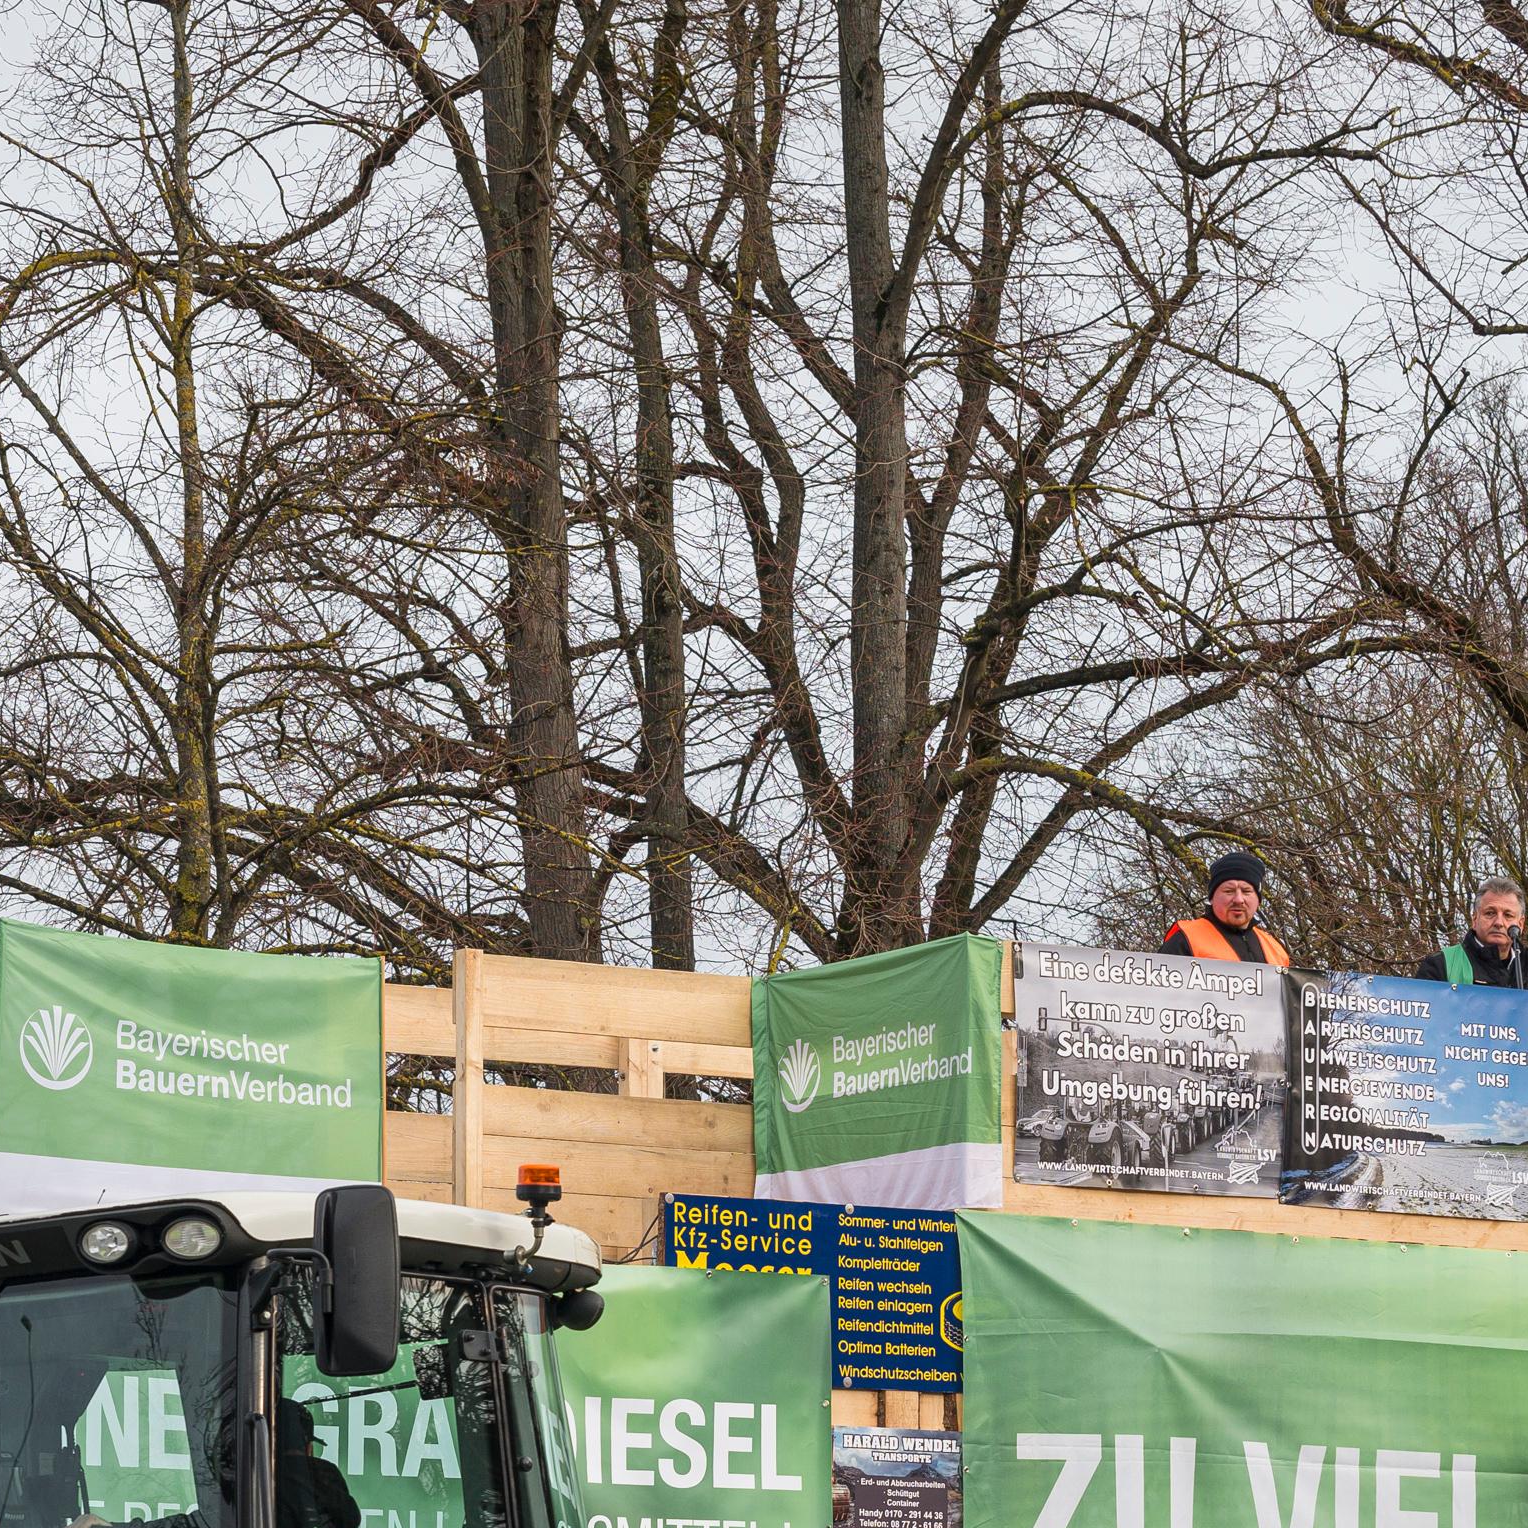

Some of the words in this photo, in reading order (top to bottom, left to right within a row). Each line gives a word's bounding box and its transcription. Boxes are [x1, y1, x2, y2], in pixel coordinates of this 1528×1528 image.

[1039, 951, 1089, 980] Eine
[1093, 955, 1183, 988] defekte
[1188, 962, 1263, 999] Ampel
[1060, 991, 1121, 1022] kann
[1125, 1004, 1155, 1025] zu
[1159, 1003, 1245, 1034] großen
[1304, 991, 1430, 1018] BIENENSCHUTZ
[1304, 1020, 1424, 1045] ARTENSCHUTZ
[1460, 1022, 1485, 1039] MIT
[1489, 1025, 1520, 1043] UNS,
[114, 1019, 290, 1066] Bayerischer
[833, 1022, 936, 1067] Bayerischer
[1057, 1031, 1159, 1064] Schäden
[1164, 1041, 1186, 1066] in
[1191, 1041, 1251, 1071] ihrer
[1304, 1048, 1437, 1074] UMWELTSCHUTZ
[1444, 1044, 1489, 1063] NICHT
[833, 1047, 972, 1098] BauernVerband
[1477, 1071, 1510, 1089] UNS!
[114, 1059, 353, 1109] BauernVerband
[1041, 1070, 1171, 1110] Umgebung
[1177, 1083, 1263, 1111] führen!
[1304, 1075, 1434, 1102] ENERGIEWENDE
[1304, 1132, 1426, 1156] NATURSCHUTZ
[1257, 1149, 1276, 1161] LSV
[1038, 1161, 1223, 1181] WWW.LANDWIRTSCHAFTVERBINDET.BAYERN
[1513, 1172, 1528, 1185] LSV
[674, 1202, 758, 1227] Reifen-
[769, 1211, 812, 1231] und
[838, 1214, 889, 1229] Sommer-
[892, 1218, 916, 1230] und
[674, 1226, 812, 1255] Kfz-Service
[839, 1234, 861, 1246] Alu-
[865, 1238, 875, 1247] u.
[879, 1237, 943, 1253] Stahlfelgen
[838, 1256, 920, 1272] Kompletträder
[838, 1277, 874, 1291] Reifen
[877, 1281, 932, 1294] wechseln
[838, 1296, 874, 1310] Reifen
[878, 1299, 933, 1315] einlagern
[838, 1318, 934, 1335] Reifendichtmittel
[838, 1340, 882, 1355] Optima
[885, 1342, 936, 1356] Batterien
[839, 1365, 957, 1382] Windschutzscheiben
[843, 1434, 899, 1450] HARALD
[902, 1437, 960, 1453] WENDEL
[872, 1452, 932, 1463] TRANSPORTE
[887, 1489, 919, 1499] Schüttgut
[891, 1480, 946, 1489] Abbrucharbeiten
[887, 1499, 919, 1507] Container
[859, 1509, 883, 1518] Handy
[885, 1510, 902, 1518] 0170
[908, 1511, 921, 1519] 291
[923, 1511, 932, 1519] 44
[859, 1519, 889, 1528] Telefon:
[901, 1521, 910, 1528] 77
